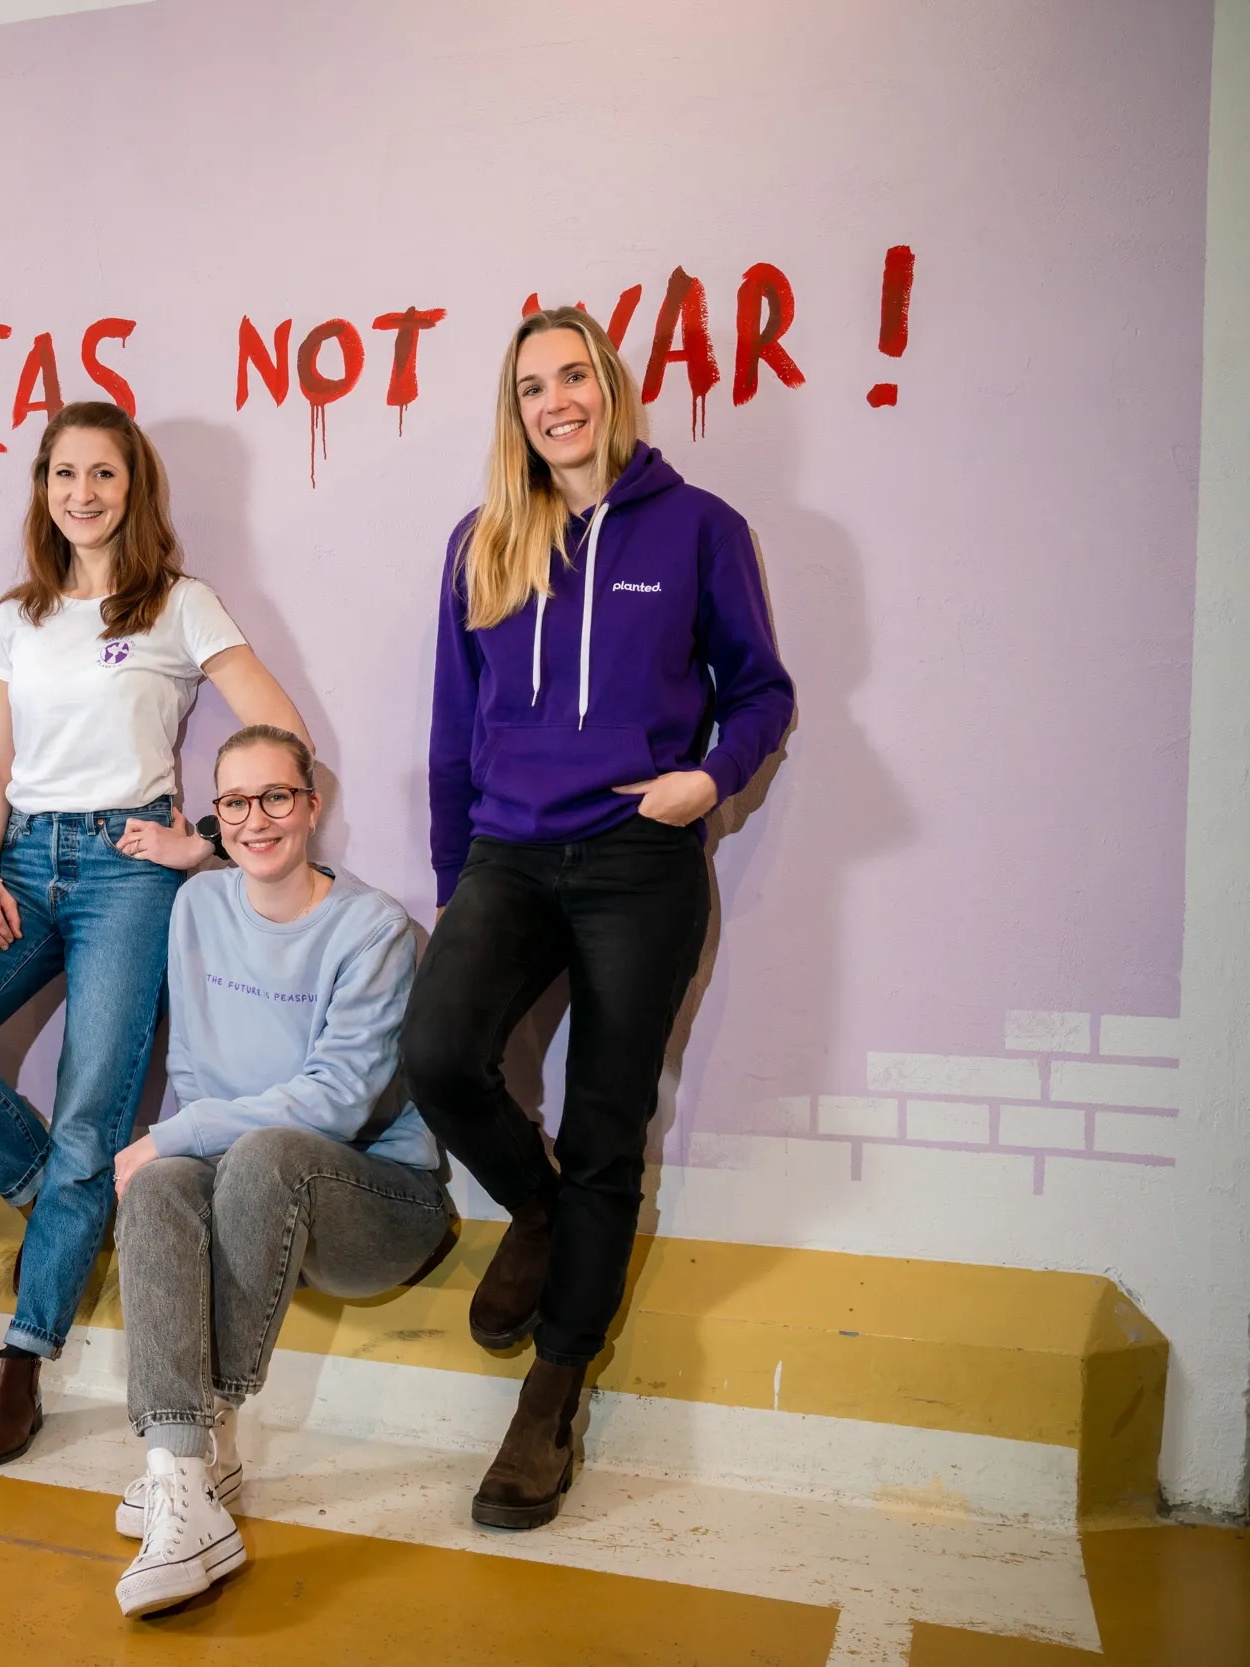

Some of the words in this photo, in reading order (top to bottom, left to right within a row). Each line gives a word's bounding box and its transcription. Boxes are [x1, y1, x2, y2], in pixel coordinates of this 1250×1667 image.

[236, 306, 448, 418] NOT
[521, 262, 807, 414] AR
[867, 244, 916, 409] !
[206, 973, 223, 986] THE
[228, 981, 262, 997] FUTURE
[263, 990, 270, 1000] IS
